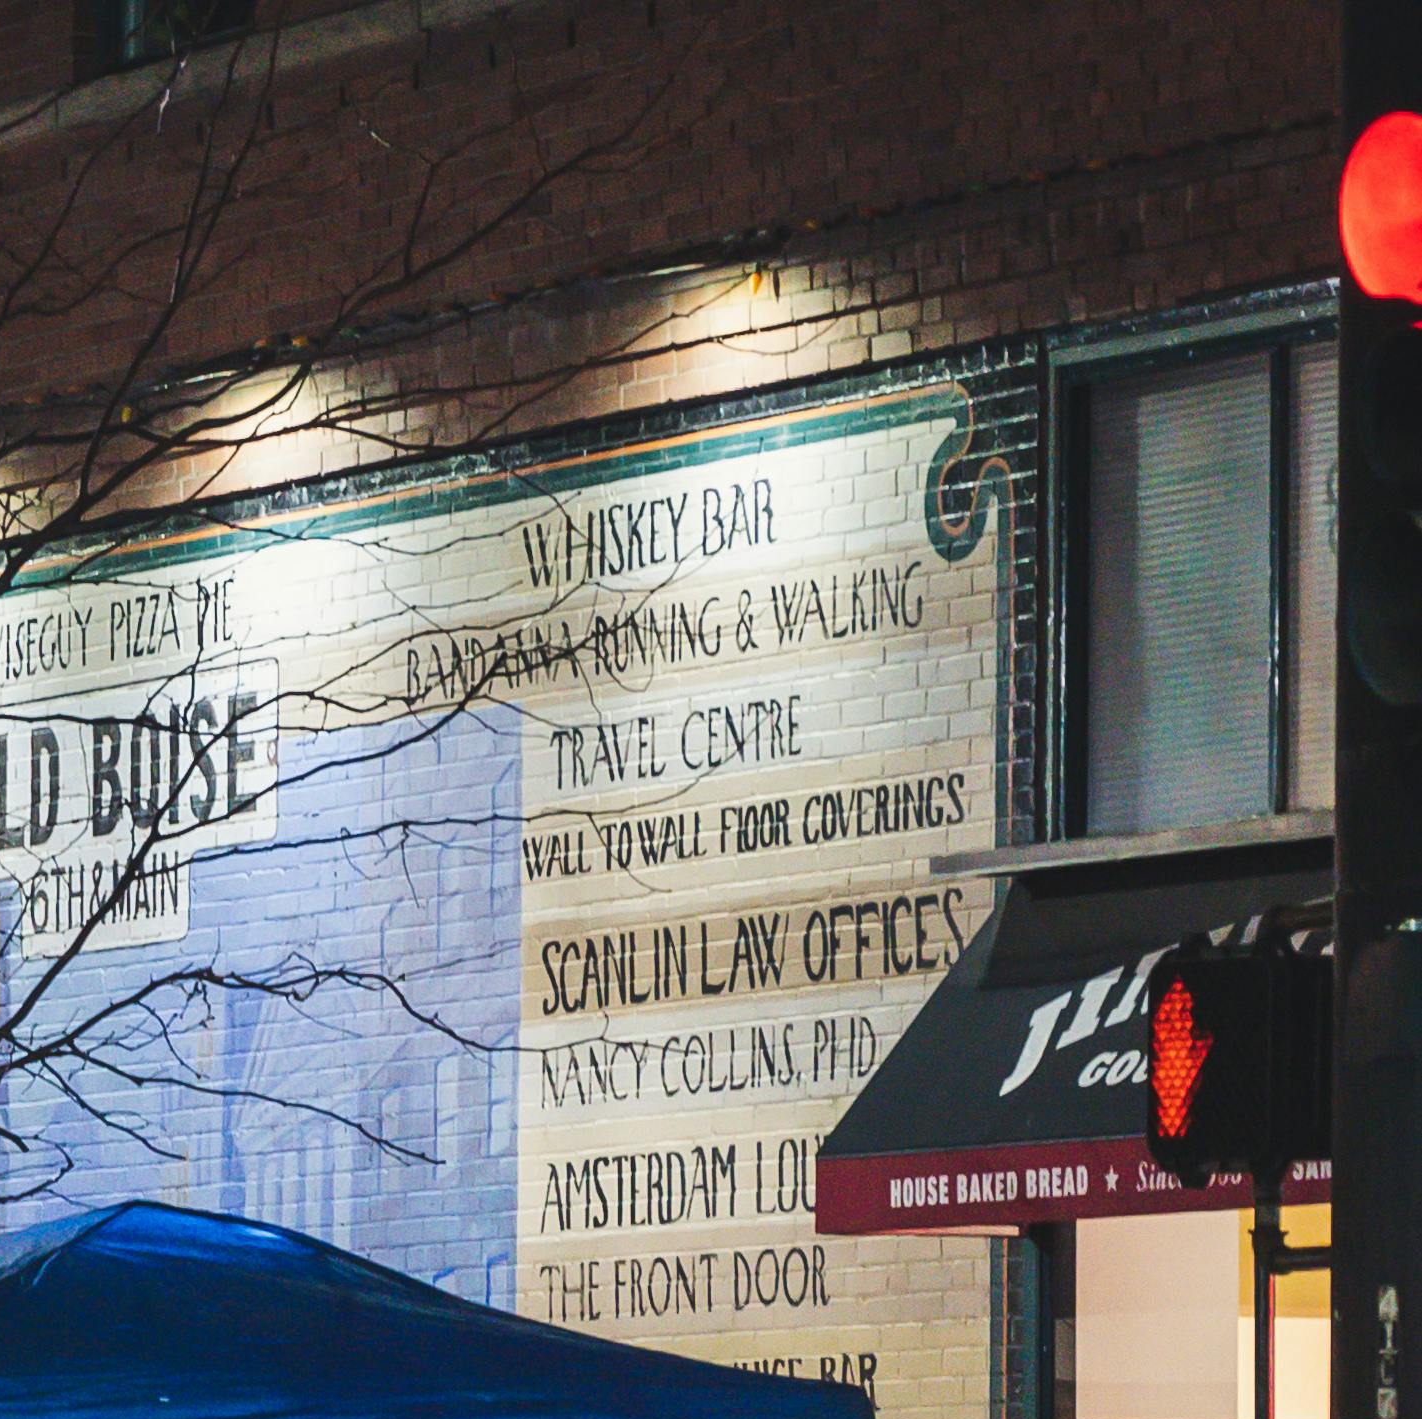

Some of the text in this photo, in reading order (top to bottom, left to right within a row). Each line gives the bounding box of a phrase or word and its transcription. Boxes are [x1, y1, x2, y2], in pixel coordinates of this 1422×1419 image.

[523, 478, 777, 588] WHISKEY BAR
[110, 586, 181, 662] PIZZA
[197, 577, 236, 649] PIE
[594, 596, 722, 676] RUNNING
[736, 588, 760, 651] &
[771, 560, 924, 646] WALKING
[93, 694, 257, 837] BOISE
[550, 695, 802, 790] TRAVEL CENTRE
[523, 773, 965, 880] WALL TO WALL FLOOR COVERINGS
[542, 887, 965, 1015] SCANLIN LAW OFFICES
[541, 1040, 649, 1109] NANCY
[813, 1016, 877, 1081] PHD
[541, 1135, 825, 1234] AMSTERDAM LOU
[890, 1175, 949, 1208] HOUSE
[957, 1171, 1017, 1204] BAKED
[1026, 1165, 1088, 1198] BREAD
[1136, 1161, 1183, 1192] Sinc
[539, 1245, 830, 1322] THE FRONT DOOR
